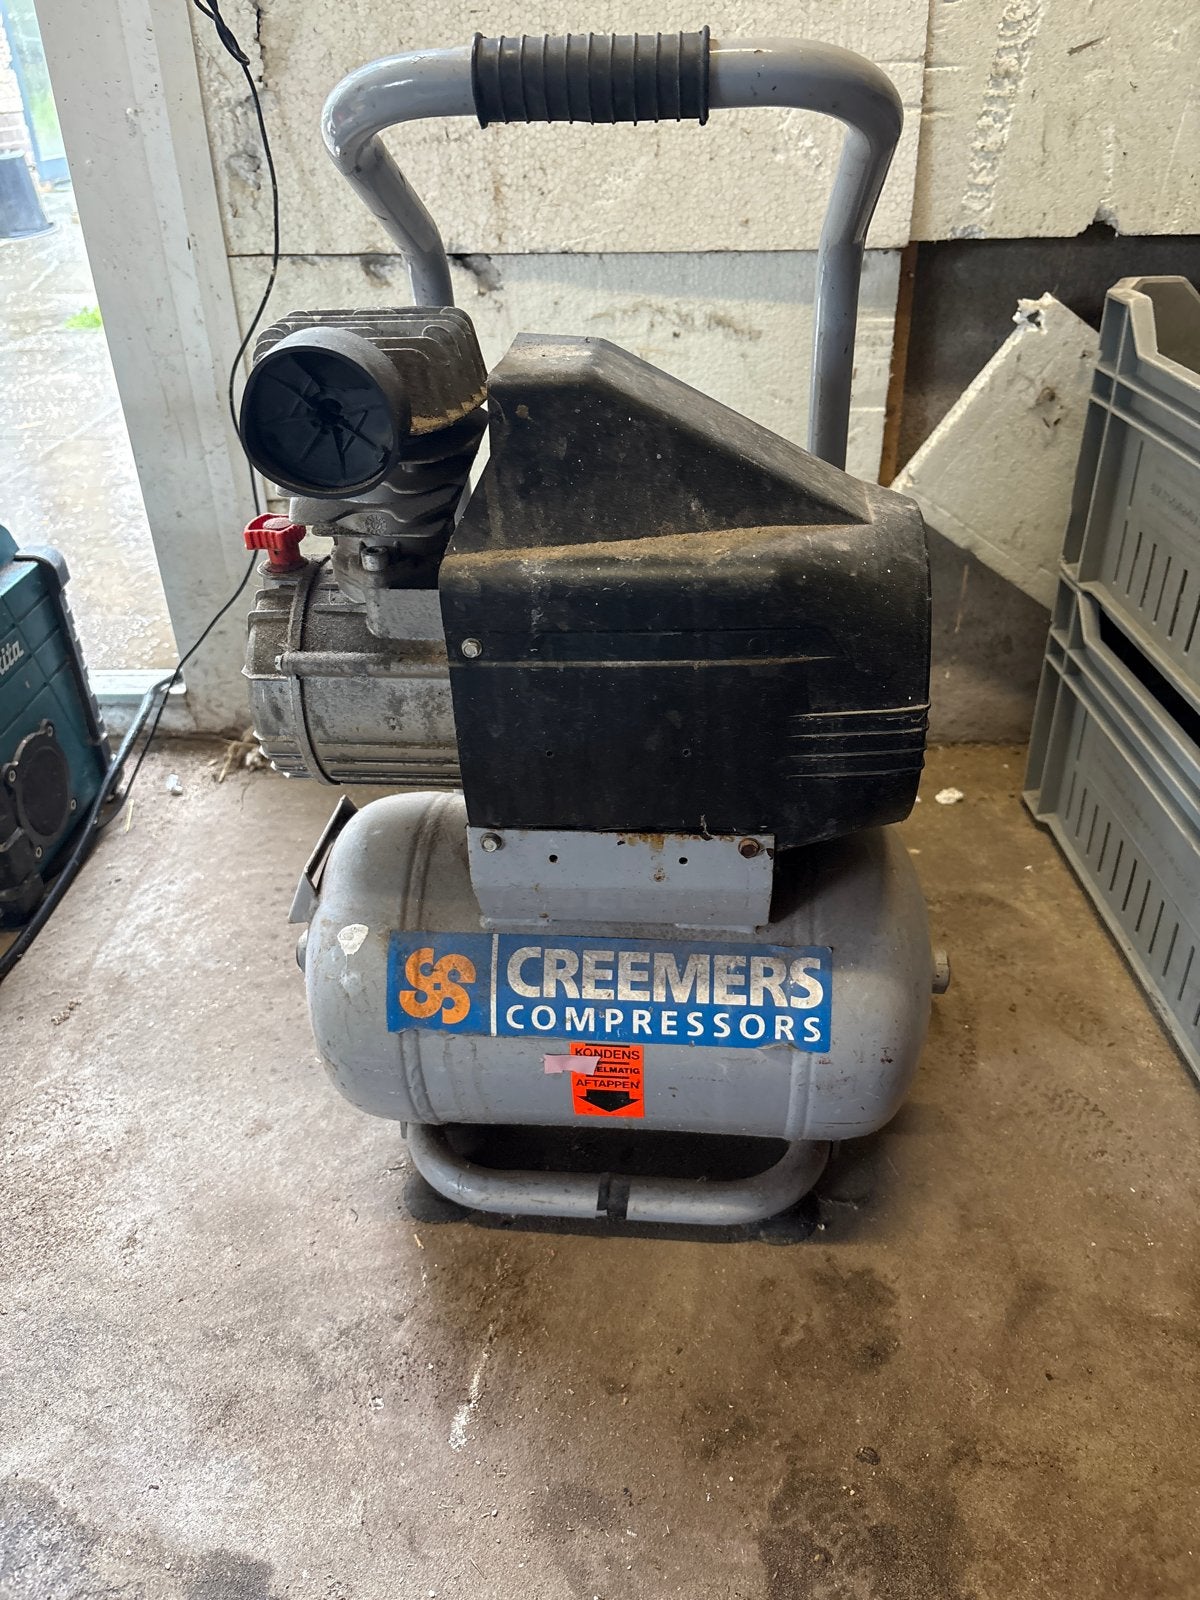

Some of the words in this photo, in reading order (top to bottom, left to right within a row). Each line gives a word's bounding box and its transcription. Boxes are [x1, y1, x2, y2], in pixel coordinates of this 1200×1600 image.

[507, 946, 823, 1009] CREEMERS
[507, 1004, 820, 1042] COMPRESSORS
[576, 1047, 640, 1060] KONDENS
[596, 1066, 639, 1075] ELMATIG
[577, 1079, 639, 1089] AFTAPPEN
